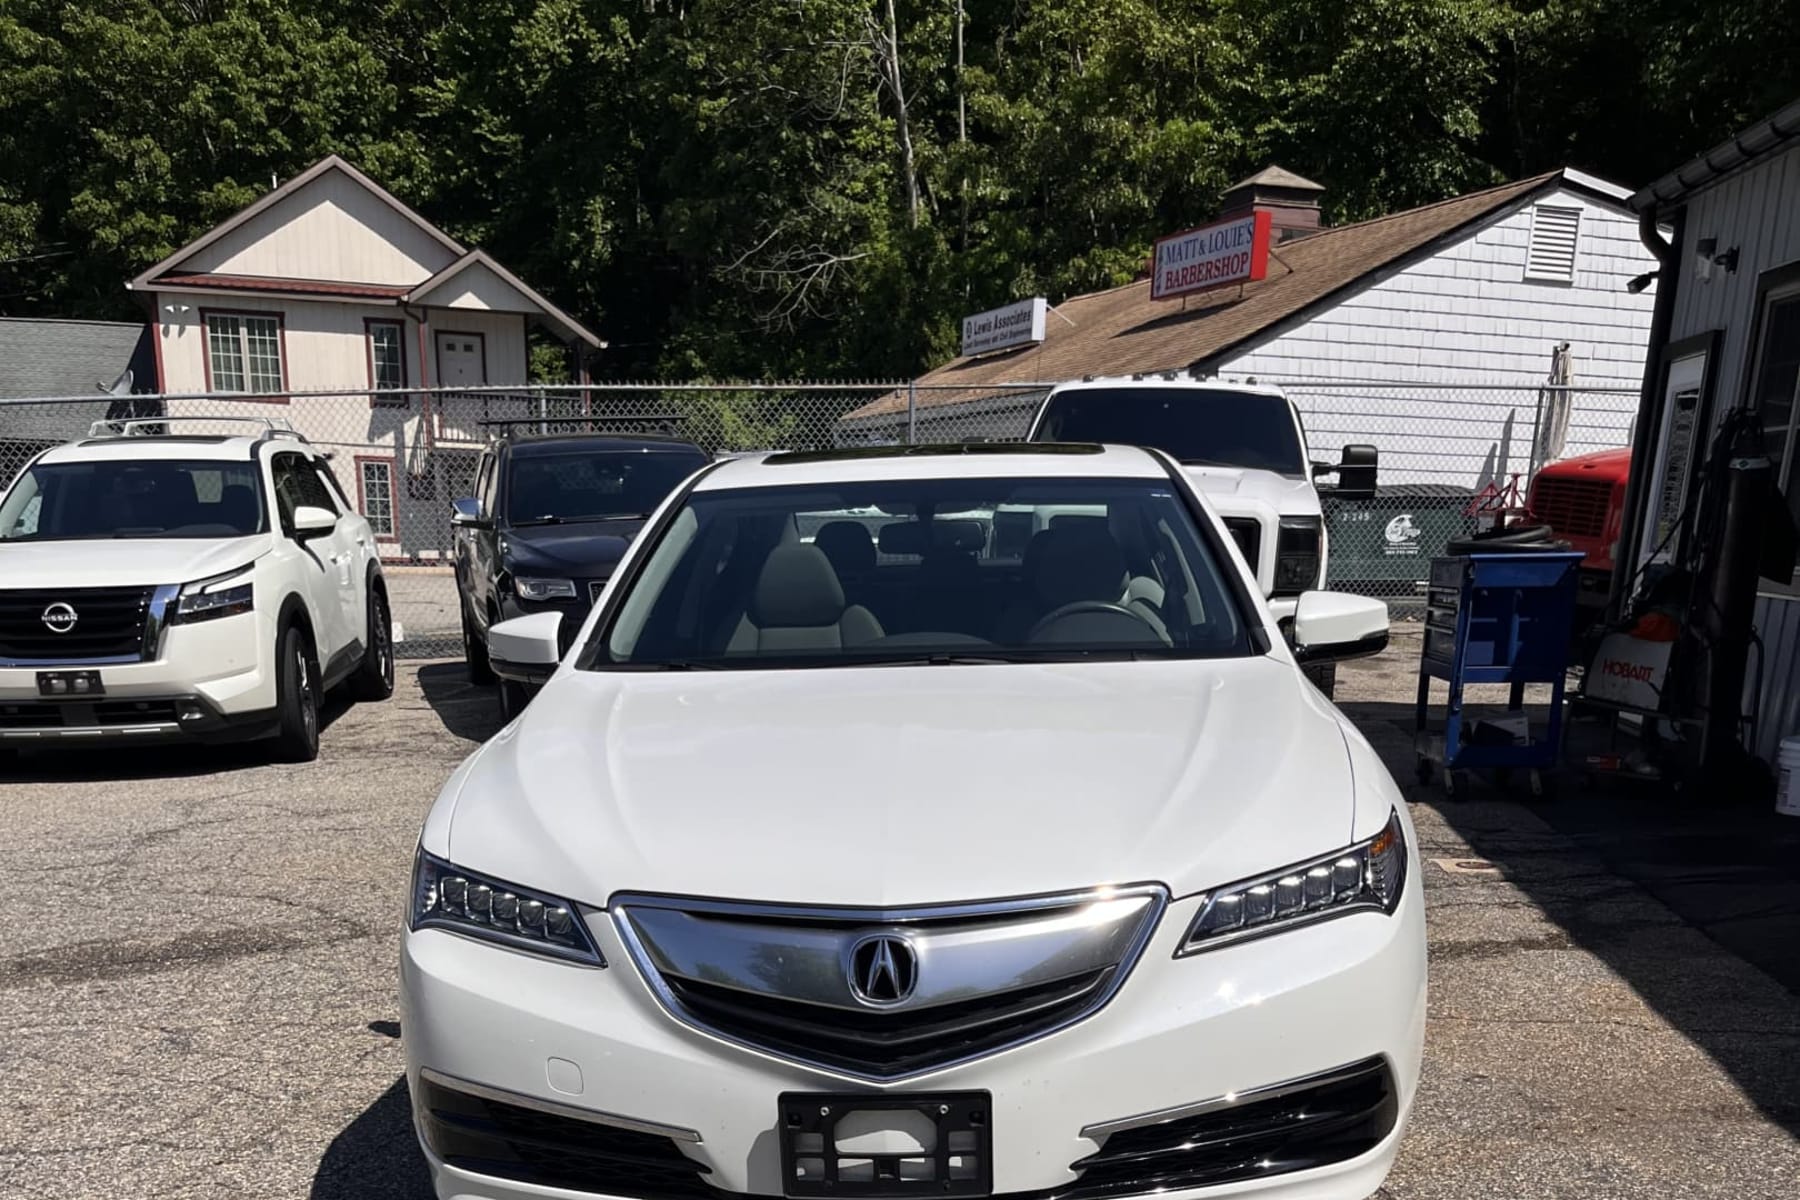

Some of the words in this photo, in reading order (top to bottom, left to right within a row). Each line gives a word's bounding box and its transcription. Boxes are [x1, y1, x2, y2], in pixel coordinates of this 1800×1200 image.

[1165, 238, 1199, 264] MATT
[1198, 239, 1206, 256] &
[1208, 222, 1253, 254] LOUIE'S
[1165, 252, 1249, 290] BARBERSHOP
[973, 319, 992, 336] Lewis
[994, 309, 1032, 330] Associates
[1602, 658, 1655, 682] HOBART
